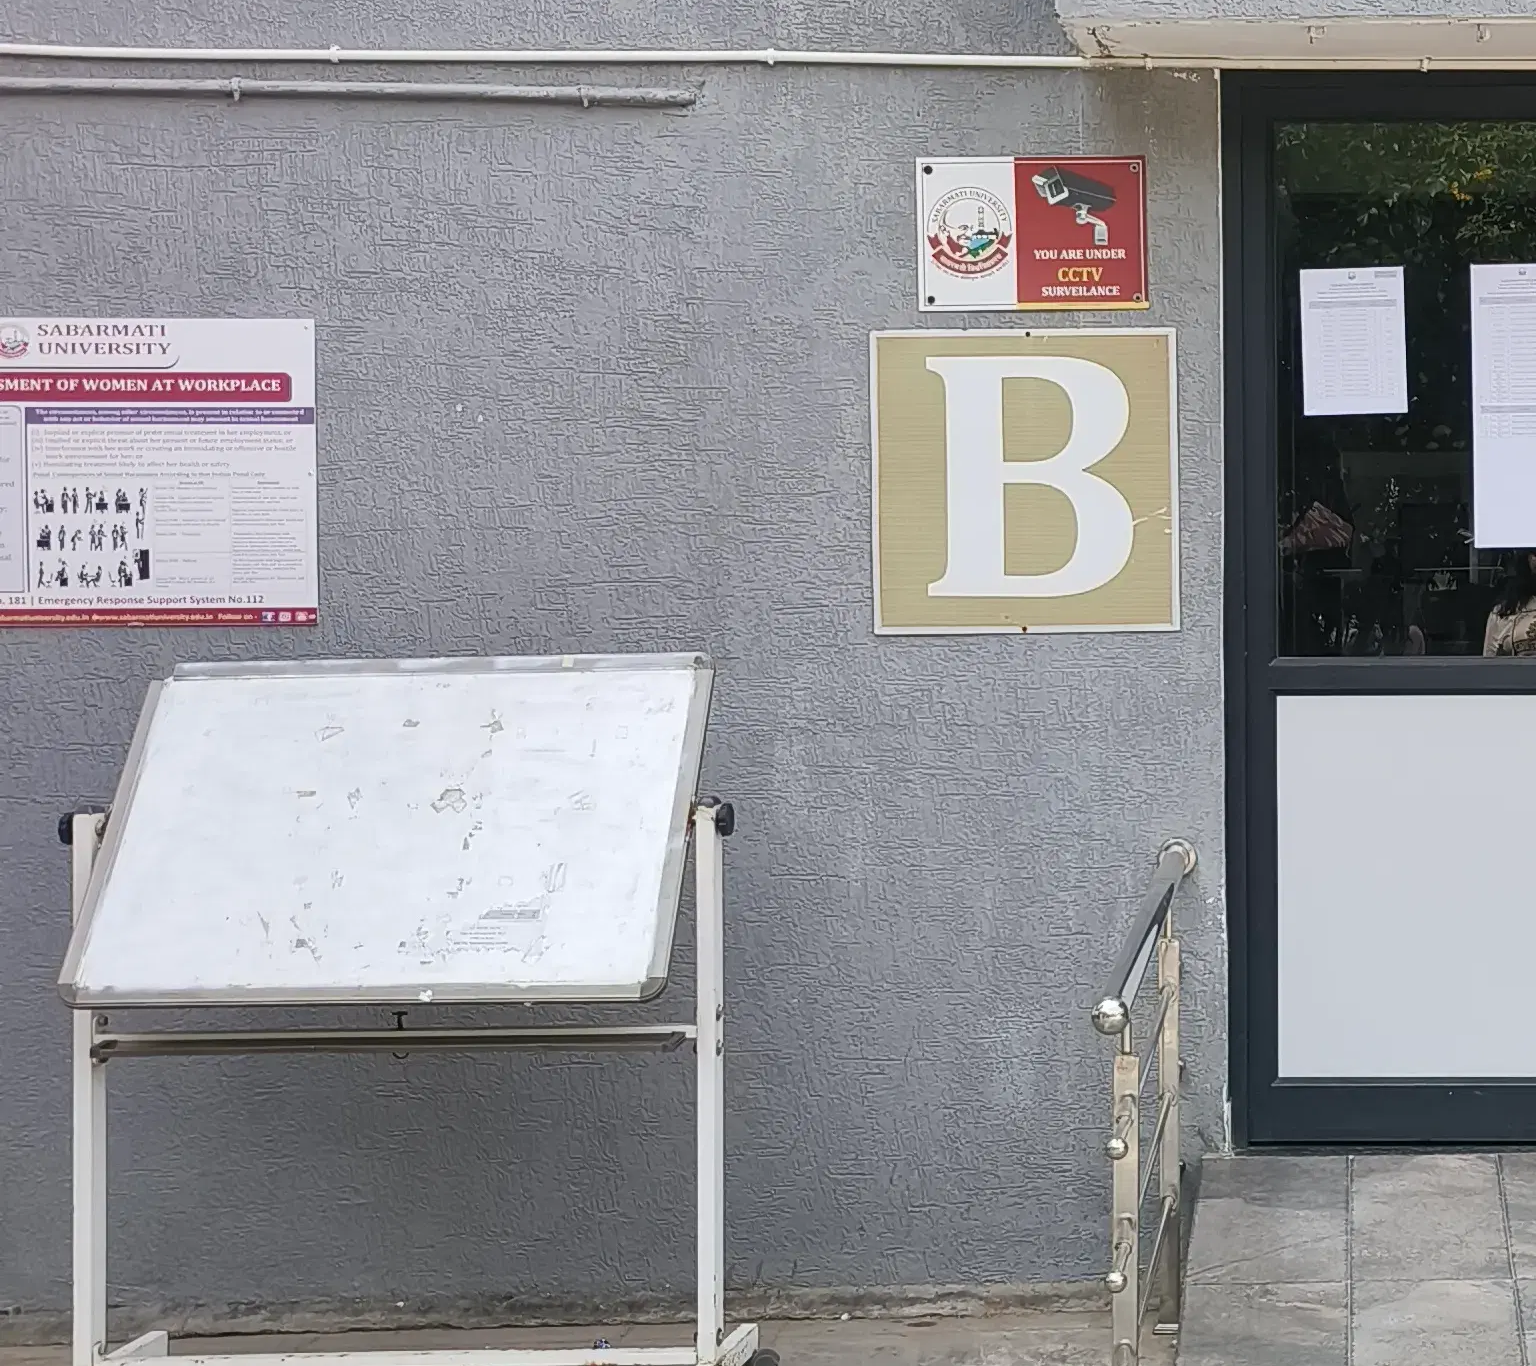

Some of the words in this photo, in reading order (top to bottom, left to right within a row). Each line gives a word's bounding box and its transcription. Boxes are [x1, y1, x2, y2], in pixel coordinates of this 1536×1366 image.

[1033, 249, 1058, 260] YOU
[1060, 249, 1084, 260] ARE
[1086, 248, 1127, 259] UNDER
[1057, 266, 1104, 282] CCTV
[1041, 285, 1121, 297] SURVEILANCE
[37, 323, 166, 337] SABARMATI
[38, 342, 173, 355] UNIVERSITY
[56, 379, 79, 392] OF
[82, 379, 148, 392] WOMEN
[150, 379, 175, 392] AT
[178, 379, 282, 392] WORKPLACE
[924, 355, 1134, 598] B
[9, 596, 26, 605] 181
[38, 596, 94, 606] Emergency
[96, 596, 145, 606] Response
[147, 595, 187, 605] Support
[190, 595, 226, 605] System
[228, 595, 265, 604] No.112
